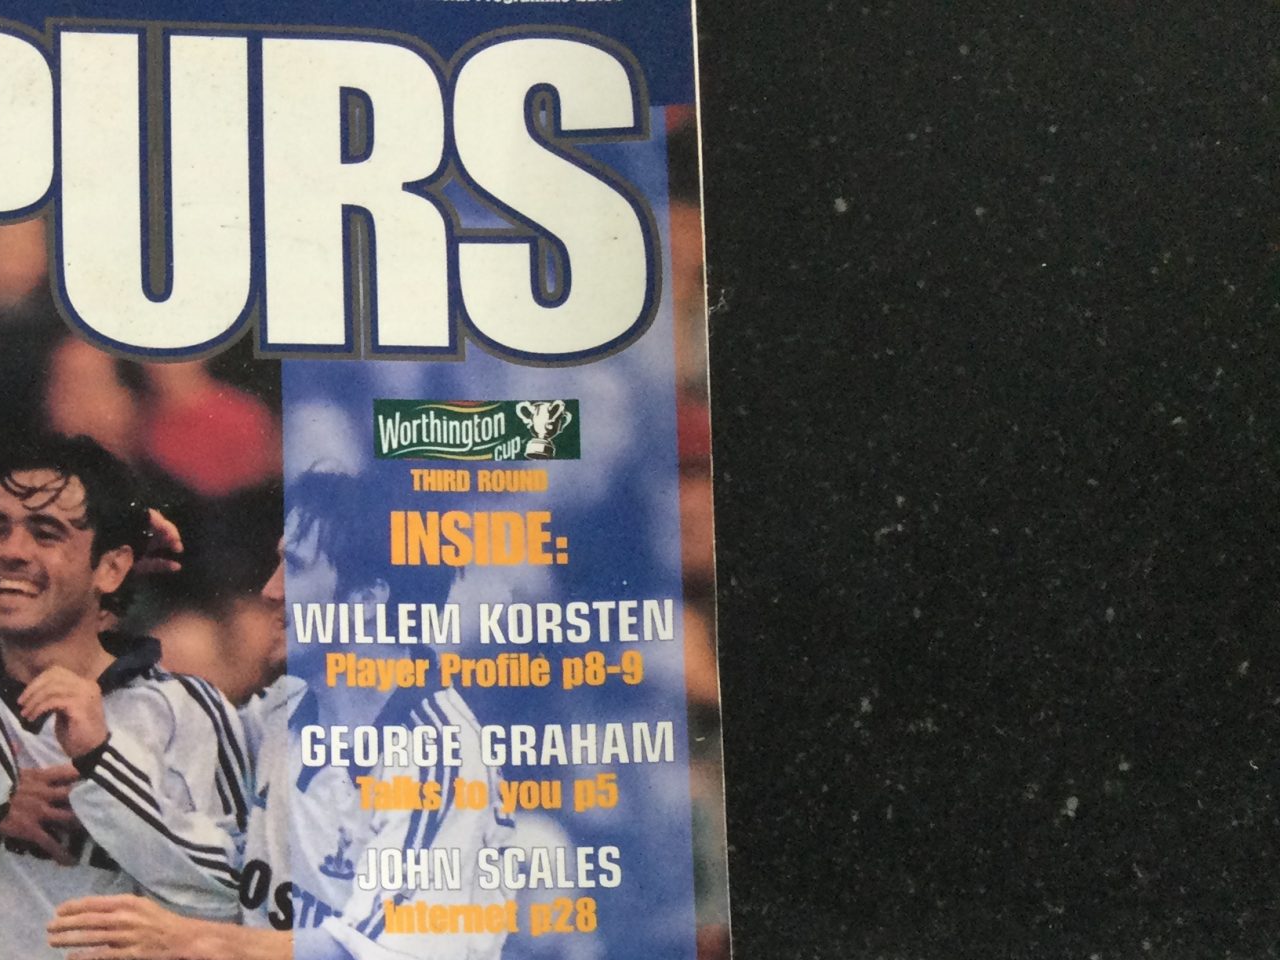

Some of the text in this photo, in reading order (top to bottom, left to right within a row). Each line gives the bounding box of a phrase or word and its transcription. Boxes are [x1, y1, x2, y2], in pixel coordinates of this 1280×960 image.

[378, 410, 506, 454] Worthington
[411, 468, 549, 493] THIRD ROUND
[390, 510, 569, 567] INSIDE:
[292, 598, 674, 645] WILLEM KORSTEN
[326, 650, 644, 692] Player Profile p8-9
[300, 720, 675, 767] GEORGE GRAHAM
[356, 773, 619, 813] Talks to you p5
[357, 845, 623, 891] JOHN SCALES
[384, 896, 598, 937] Internet p28
